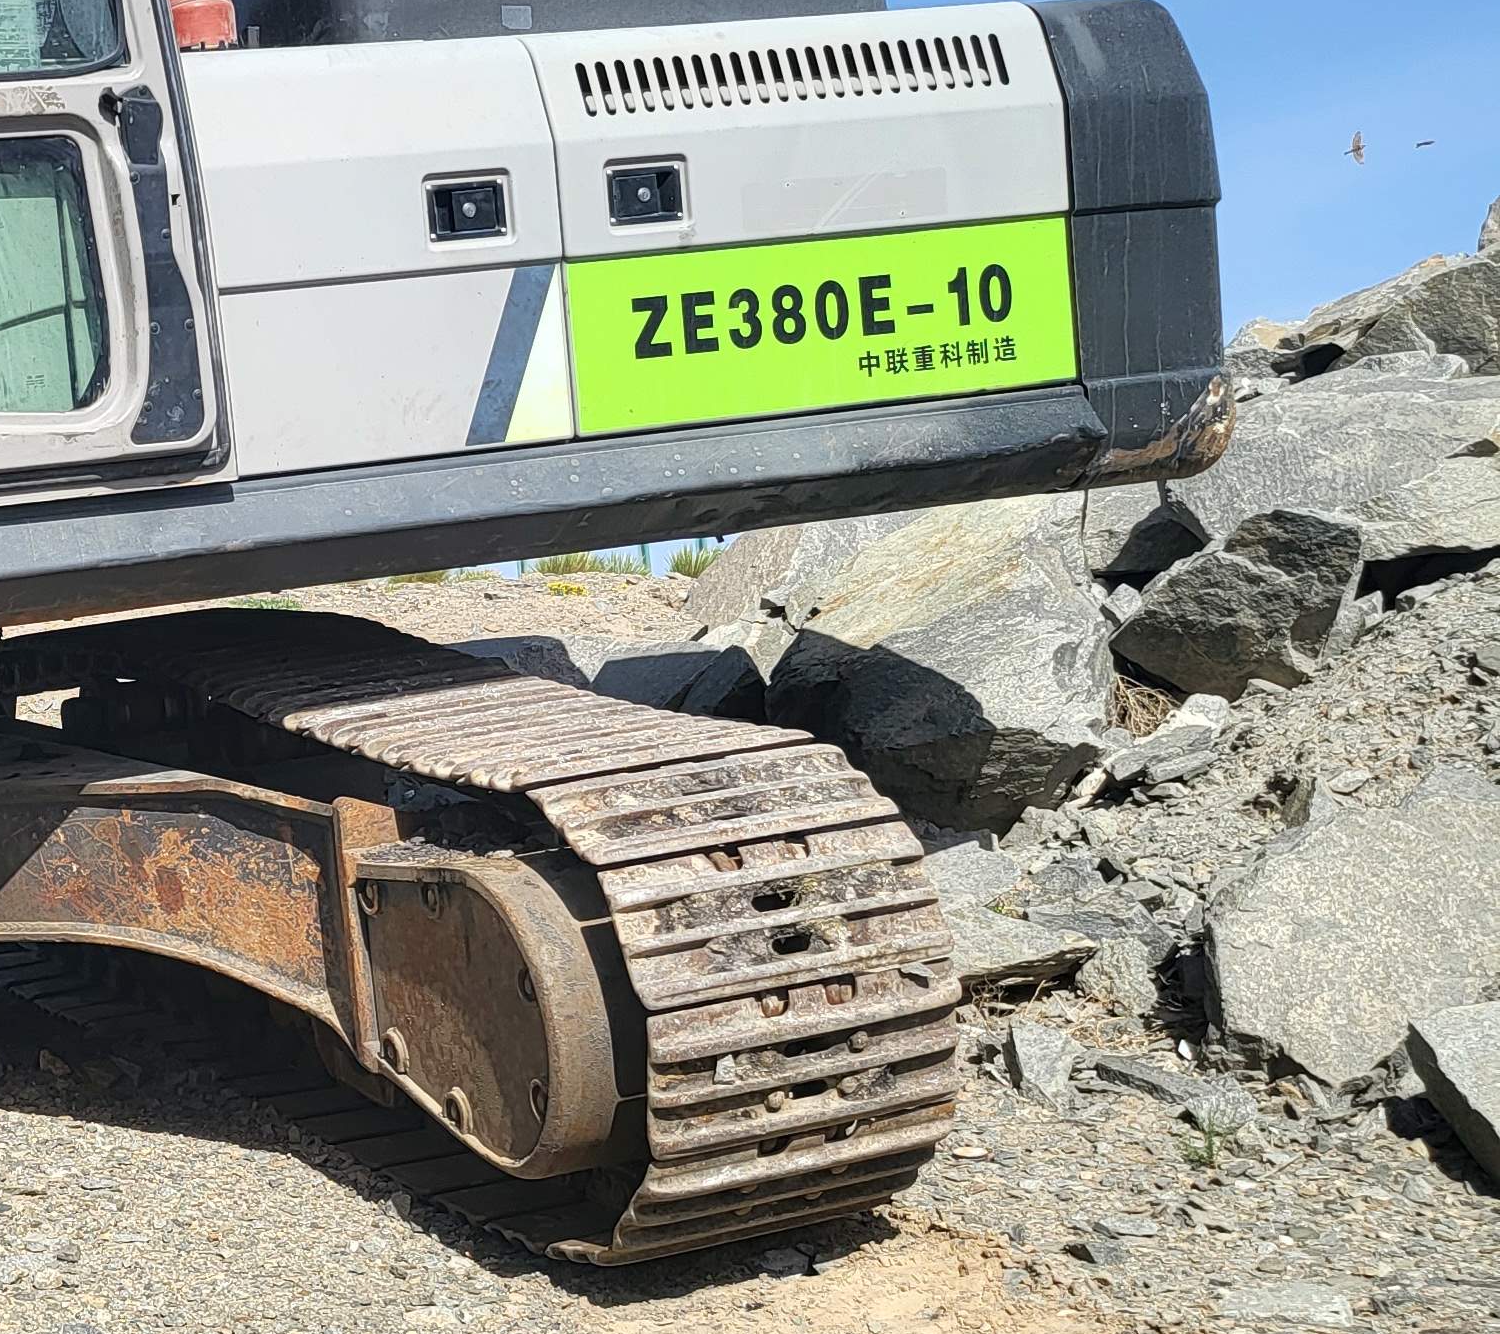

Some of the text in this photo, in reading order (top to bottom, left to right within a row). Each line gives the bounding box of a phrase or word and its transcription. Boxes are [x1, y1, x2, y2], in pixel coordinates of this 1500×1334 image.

[631, 263, 1012, 359] ZE380E-10
[858, 335, 1018, 377] 中联重科制造
